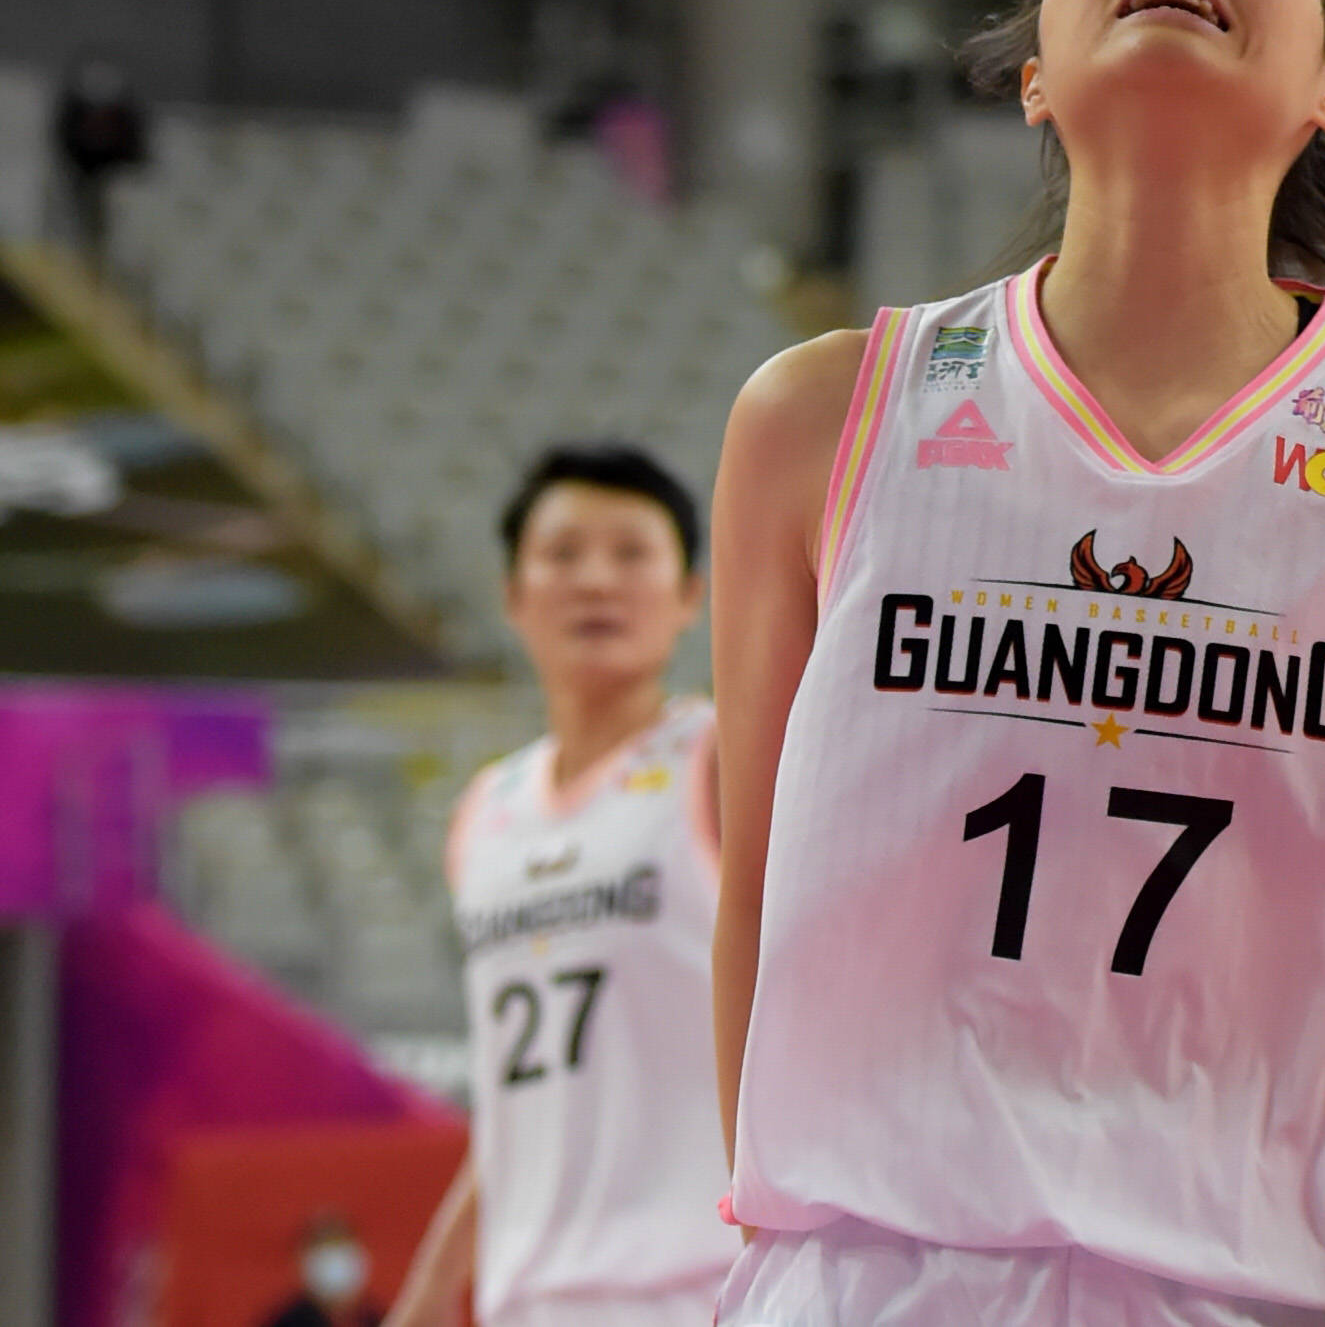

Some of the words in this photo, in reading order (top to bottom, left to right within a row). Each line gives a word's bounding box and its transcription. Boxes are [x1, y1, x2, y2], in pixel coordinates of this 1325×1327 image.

[951, 590, 1059, 613] WOMEN
[1089, 602, 1302, 646] BASKETBALL
[963, 772, 1235, 977] 17
[492, 962, 610, 1088] 27
